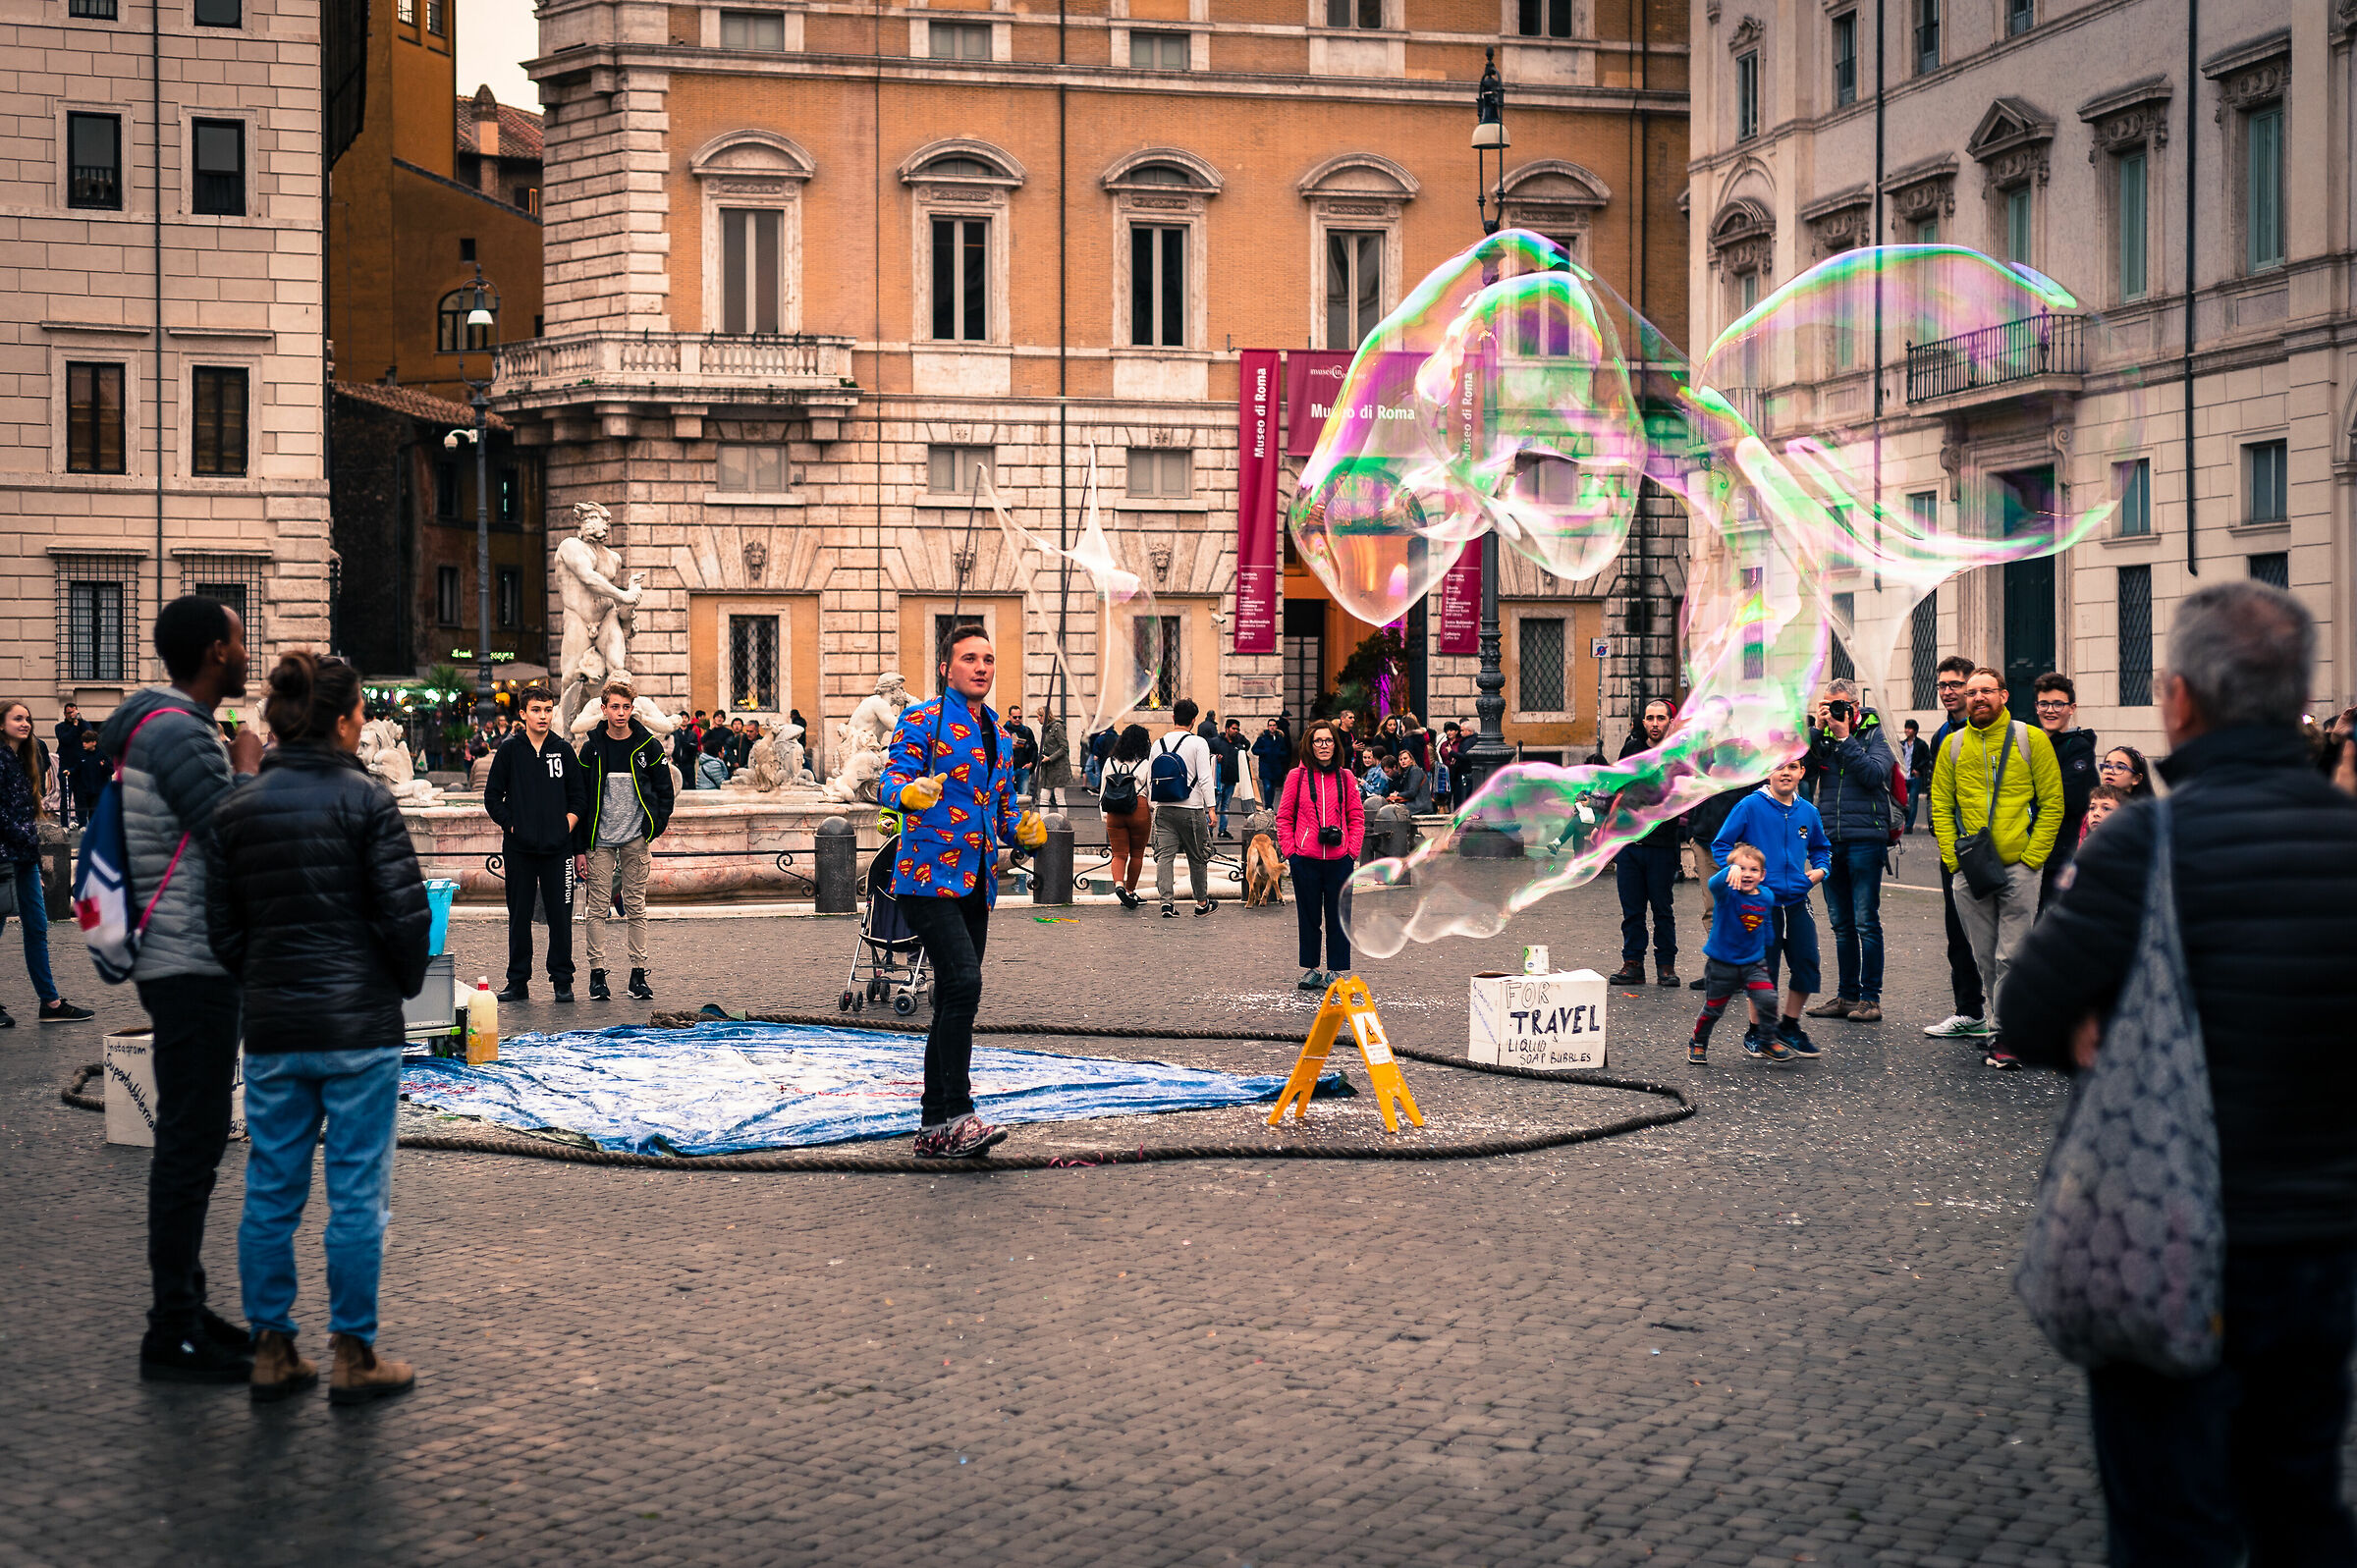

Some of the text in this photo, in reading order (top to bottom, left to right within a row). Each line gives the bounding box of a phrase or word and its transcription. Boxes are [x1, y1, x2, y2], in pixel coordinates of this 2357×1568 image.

[1462, 372, 1473, 406] Roma
[1254, 367, 1267, 459] Museo di Roma
[1311, 404, 1415, 420] Muo di Roma
[1462, 408, 1472, 420] di
[546, 758, 564, 778] 19
[1506, 982, 1551, 1009] FOR
[1509, 1004, 1601, 1036] TRAVEL
[106, 1041, 146, 1056] Instagram
[1508, 1038, 1547, 1054] LIQUID
[1519, 1052, 1592, 1066] SOAP BUBBLES
[103, 1053, 156, 1132] Superbubblema
